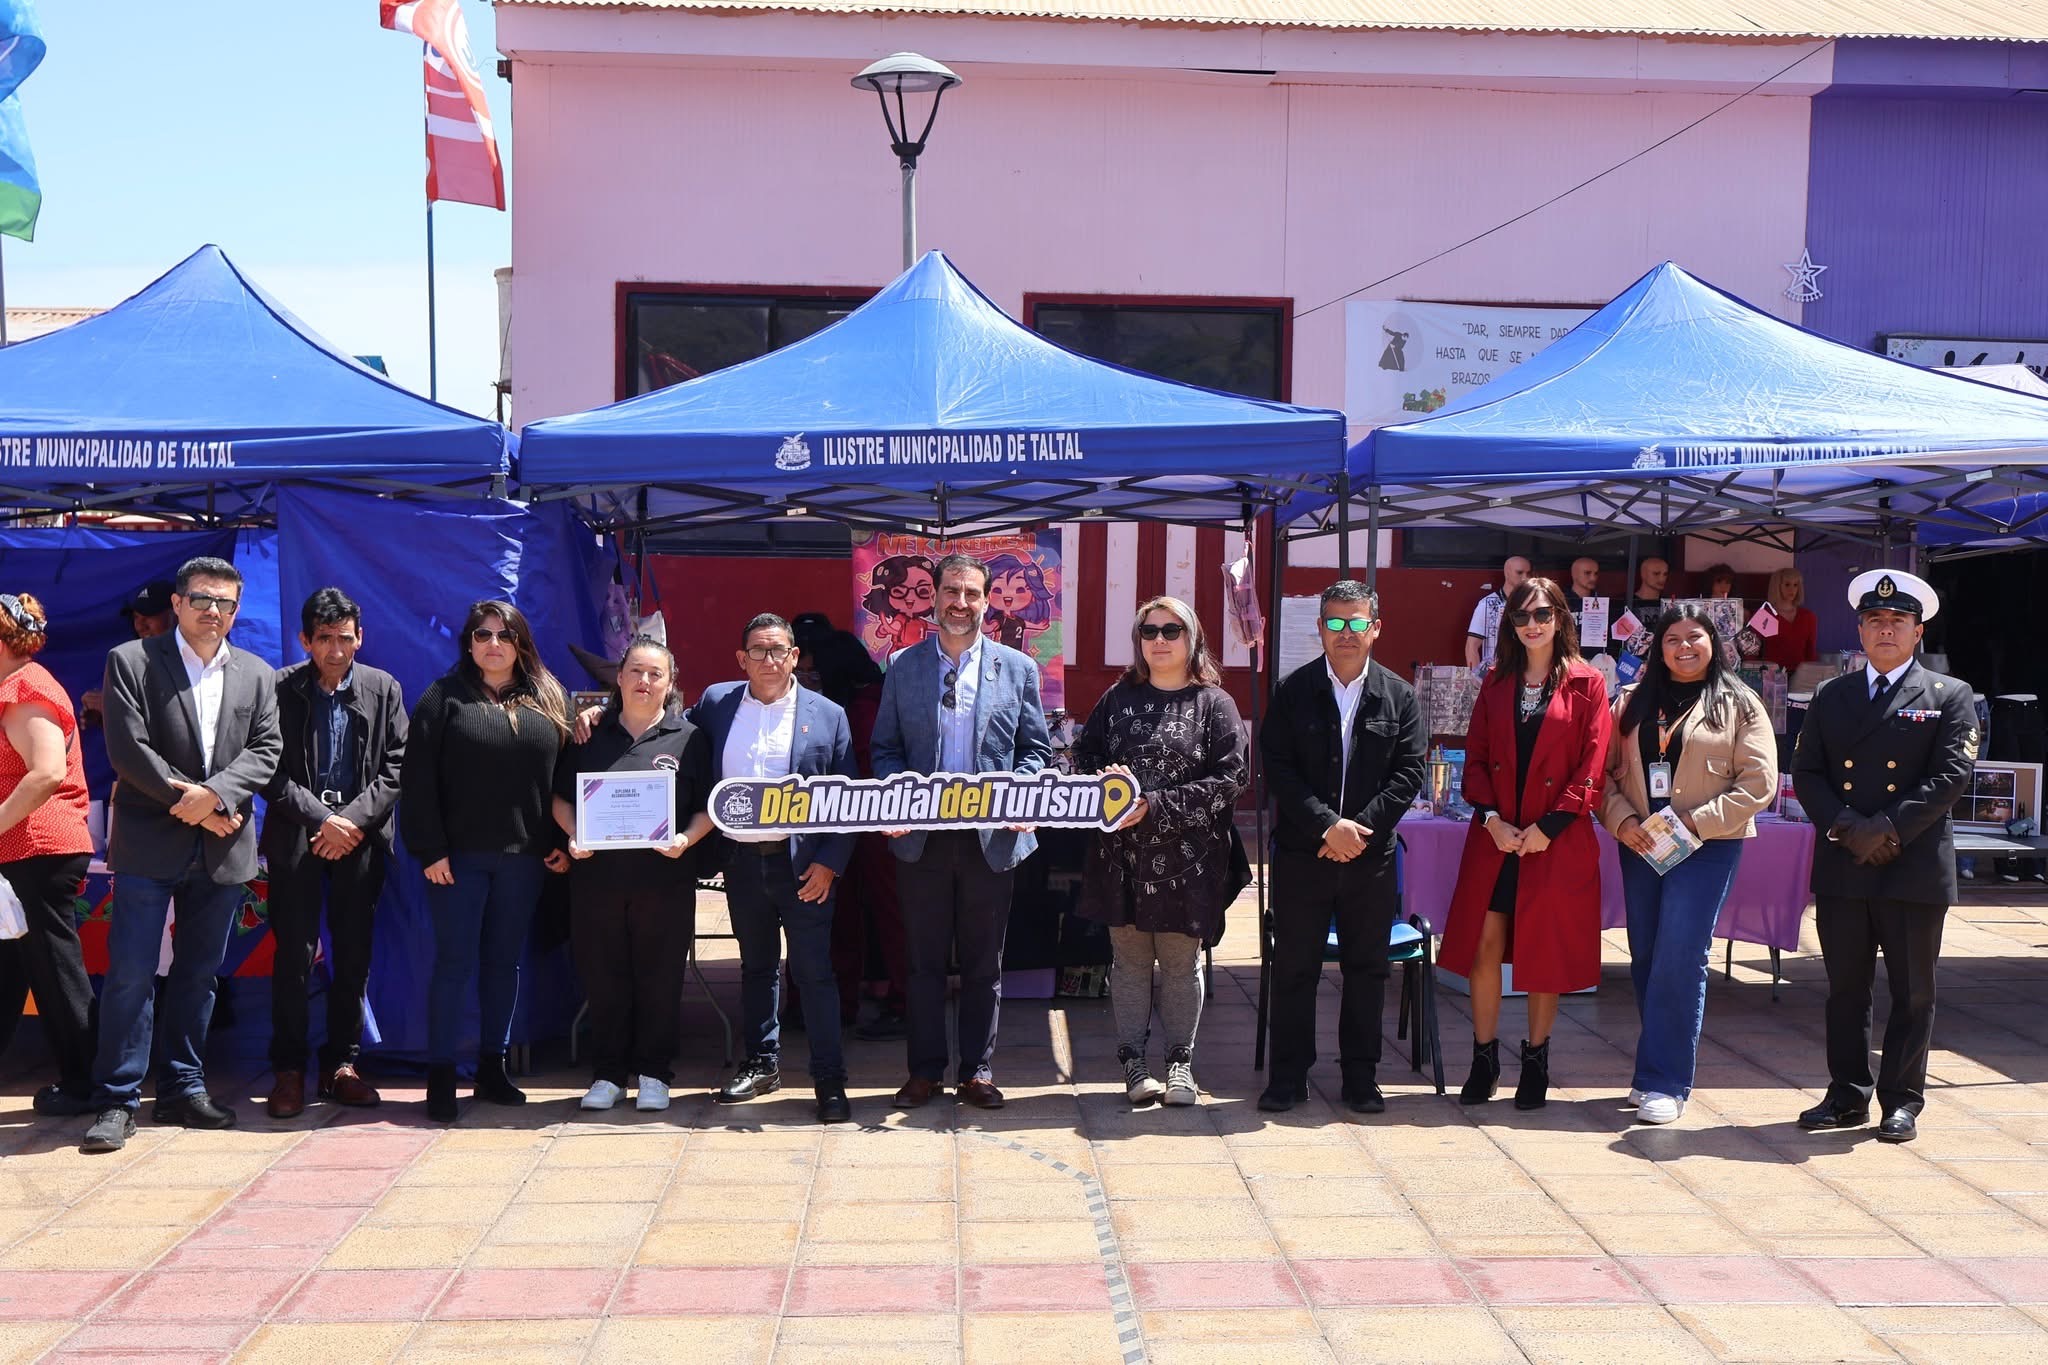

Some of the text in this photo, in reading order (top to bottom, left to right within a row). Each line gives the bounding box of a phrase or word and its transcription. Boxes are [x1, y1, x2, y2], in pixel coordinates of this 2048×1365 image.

[1499, 325, 1541, 339] SIEMPRE
[1436, 347, 1466, 360] HASTA
[1478, 349, 1498, 362] QUE
[1509, 351, 1522, 363] SE
[1451, 372, 1490, 385] BRAZOS
[0, 438, 235, 468] TRE MUNICIPALIDAD DE TALTAL
[823, 432, 1083, 466] ILUSTRE MUNICIPALIDAD DE TALTAL
[1015, 626, 1022, 639] 2
